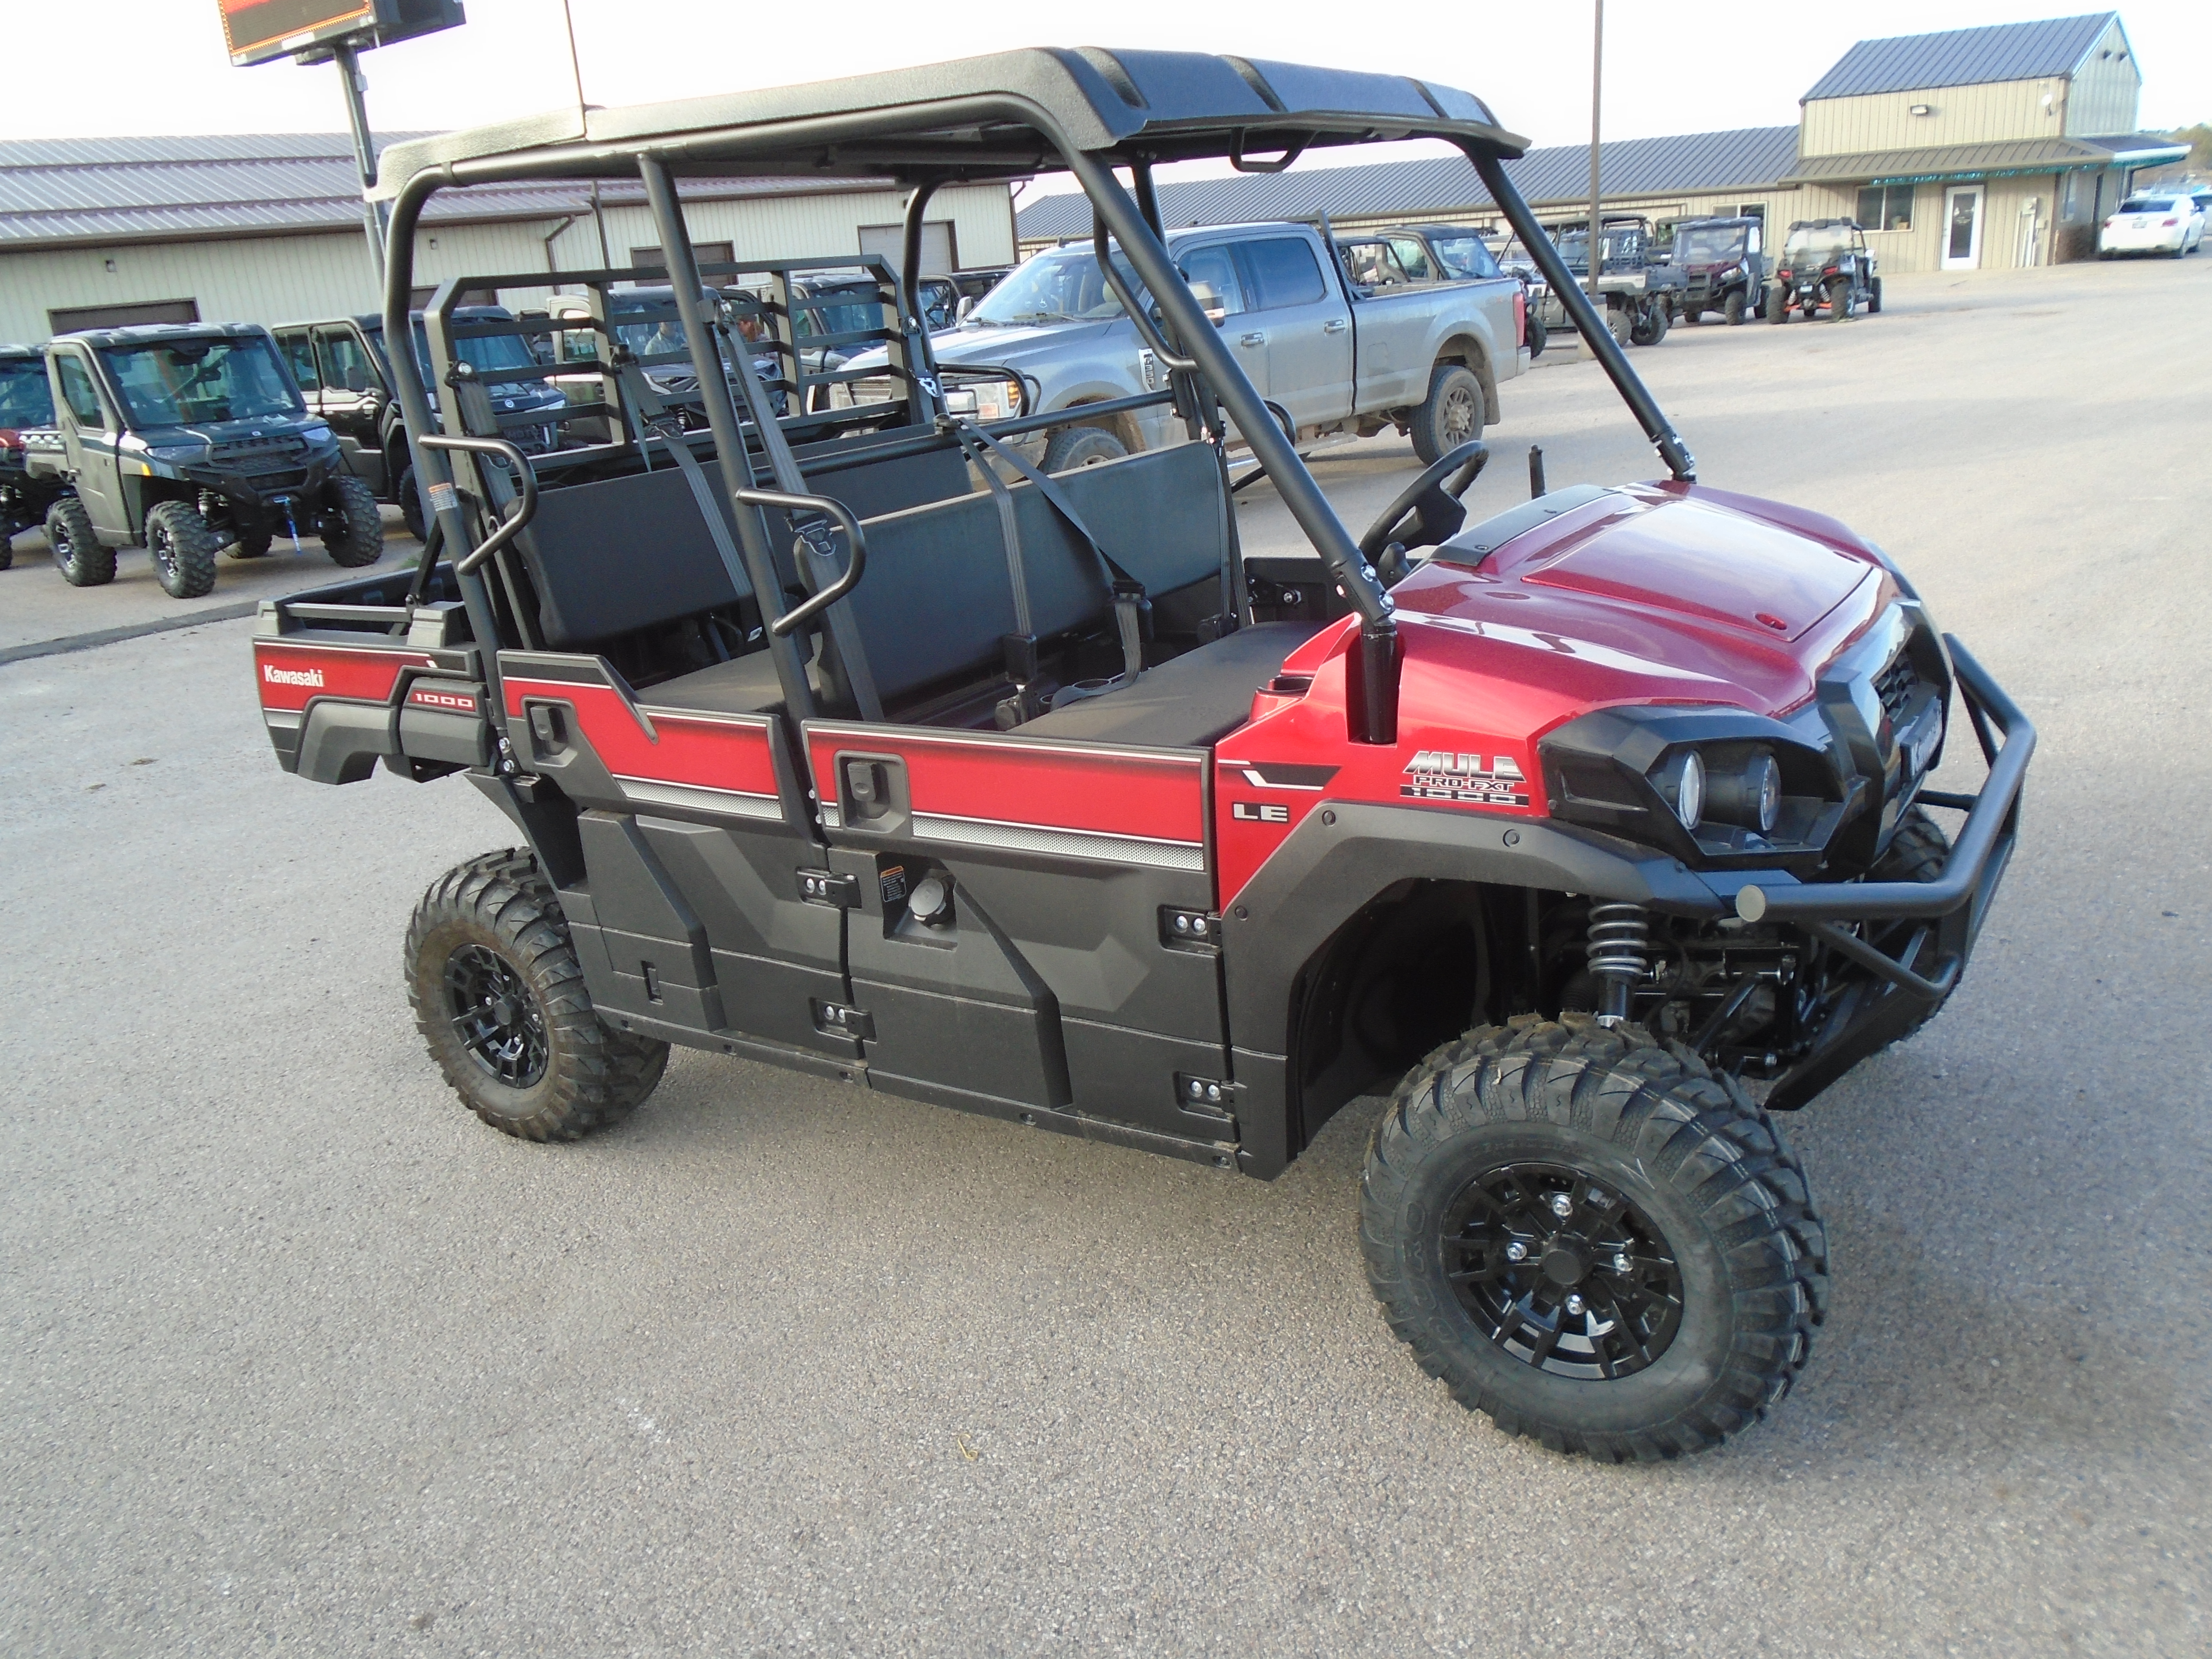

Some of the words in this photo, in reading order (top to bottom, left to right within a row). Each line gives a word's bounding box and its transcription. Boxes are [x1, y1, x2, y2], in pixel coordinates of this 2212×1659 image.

[264, 665, 323, 687] Kawasaki
[416, 693, 472, 707] 1000
[1402, 751, 1527, 782] MULE
[1413, 775, 1514, 792] PRO-FXT
[1411, 787, 1516, 804] 1000
[1234, 804, 1287, 821] LE
